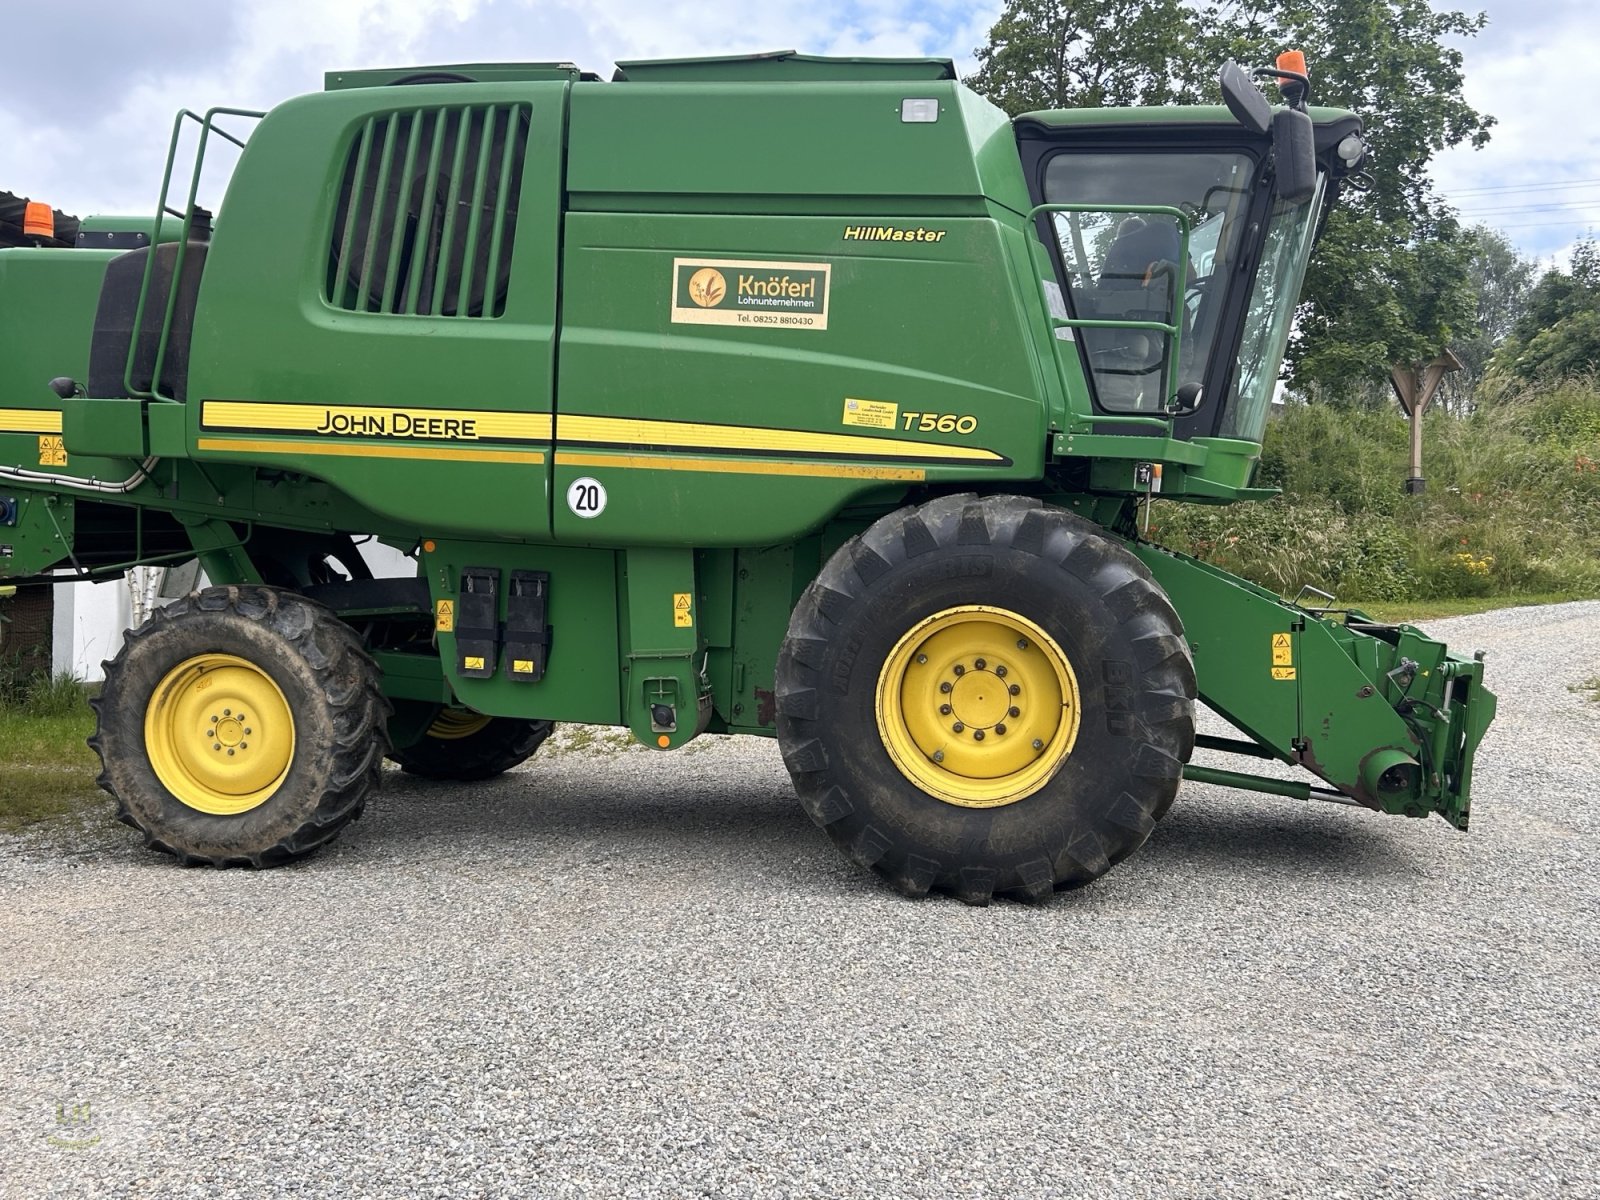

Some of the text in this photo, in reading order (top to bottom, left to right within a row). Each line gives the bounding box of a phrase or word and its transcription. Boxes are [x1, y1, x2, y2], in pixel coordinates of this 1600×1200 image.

[843, 226, 946, 242] HillMaster
[738, 274, 816, 298] Knöferl
[737, 296, 815, 308] Lohnunternehmen
[737, 314, 814, 326] Tel. 08252 8810430
[317, 410, 477, 437] JOHN DEERE
[902, 412, 978, 434] T560
[575, 484, 599, 511] 20
